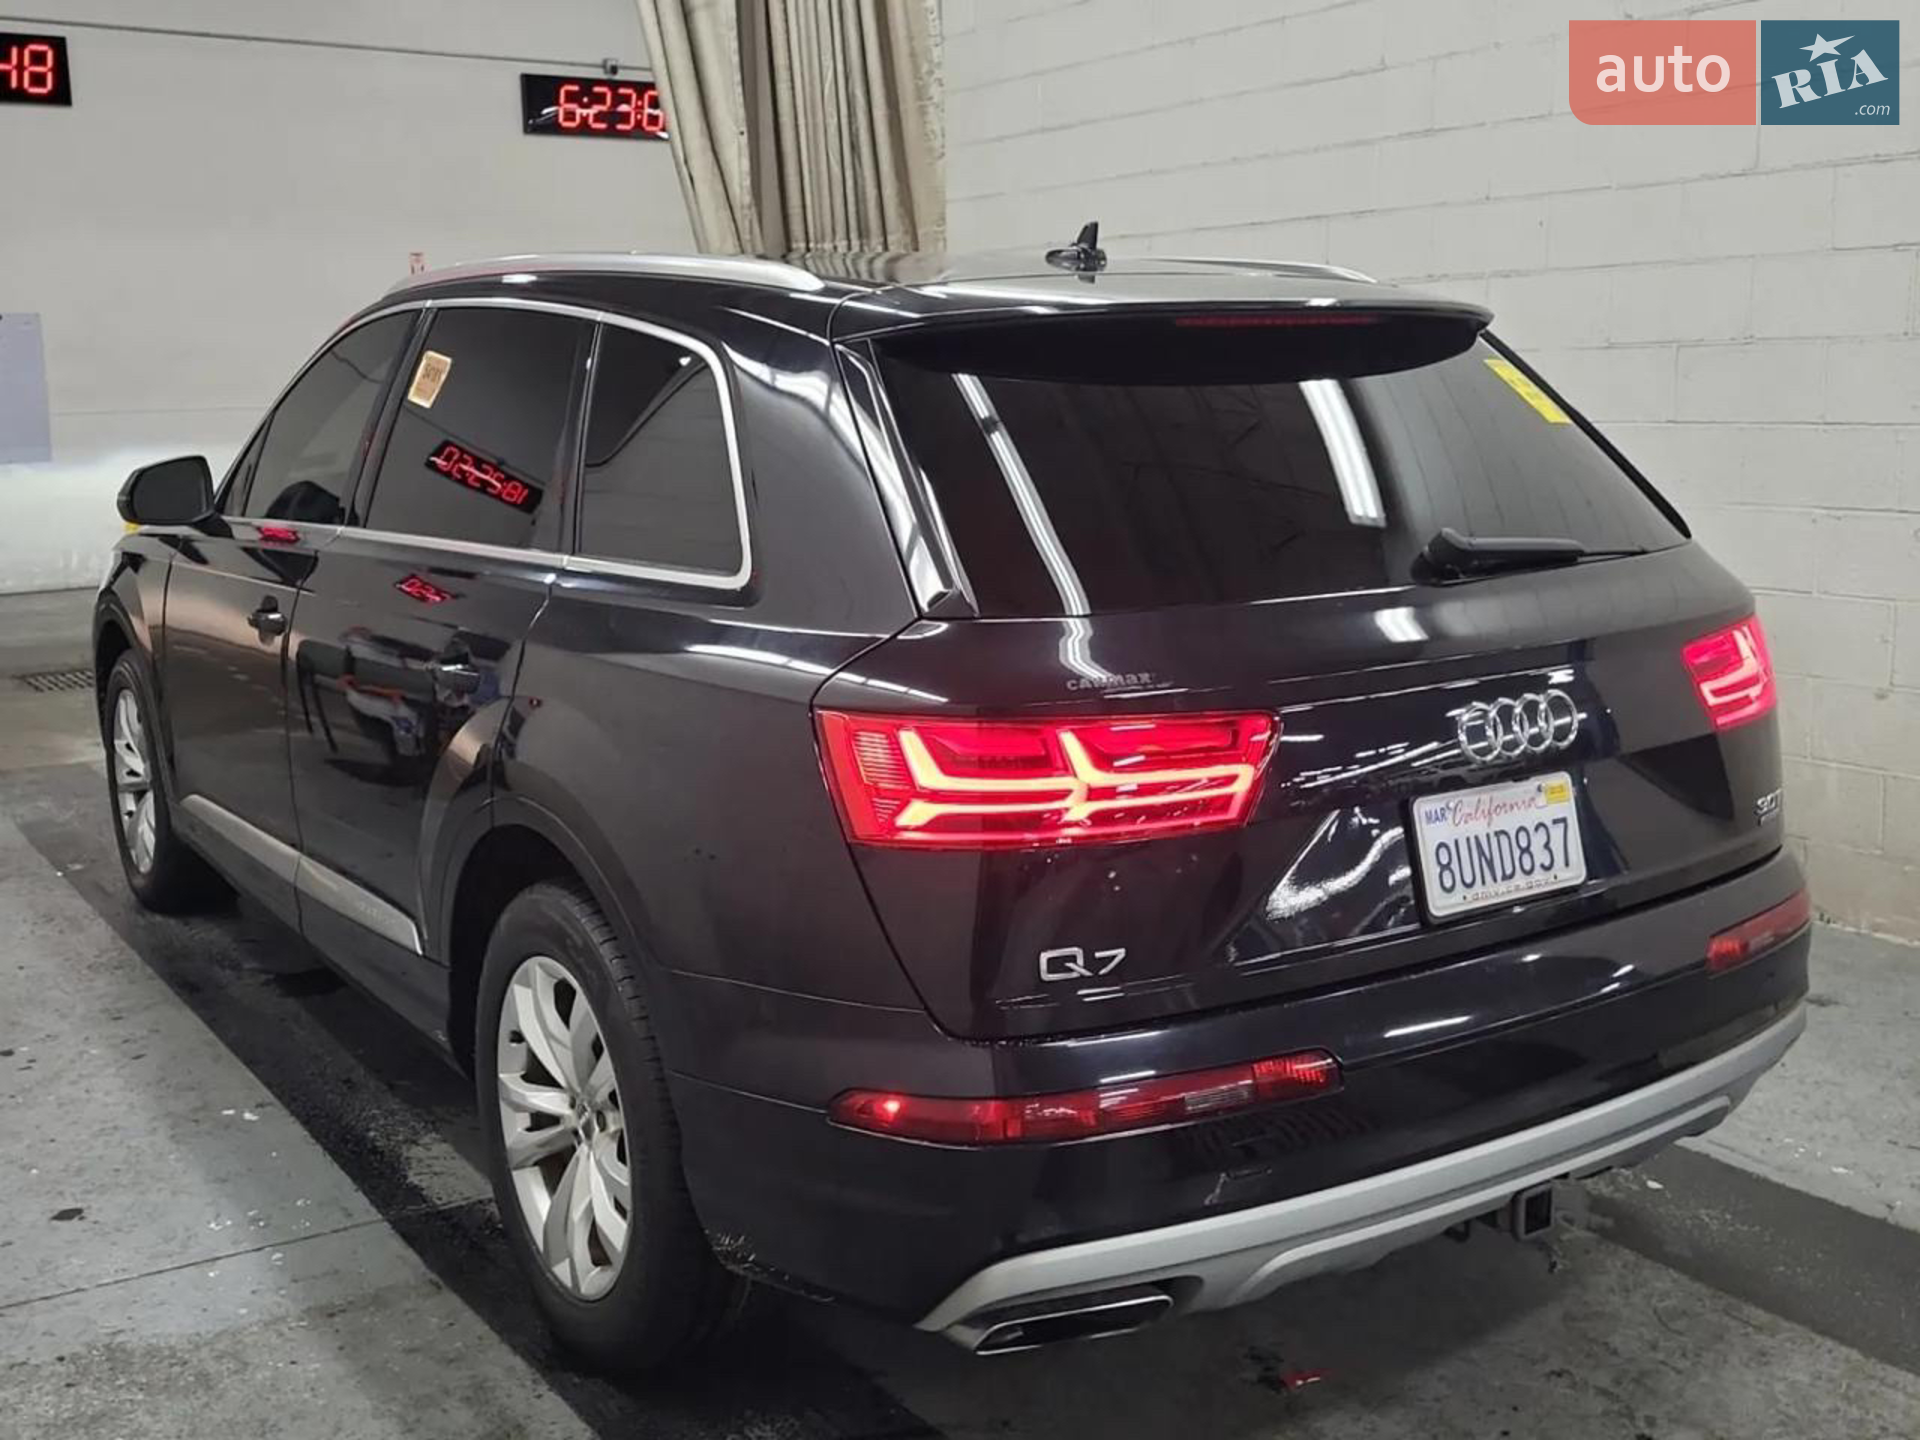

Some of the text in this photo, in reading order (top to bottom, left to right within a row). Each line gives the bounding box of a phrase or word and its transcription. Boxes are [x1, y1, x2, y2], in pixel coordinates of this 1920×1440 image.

[1425, 795, 1548, 828] MAR California
[1435, 816, 1570, 894] 8UND837
[1039, 946, 1126, 982] Q7
